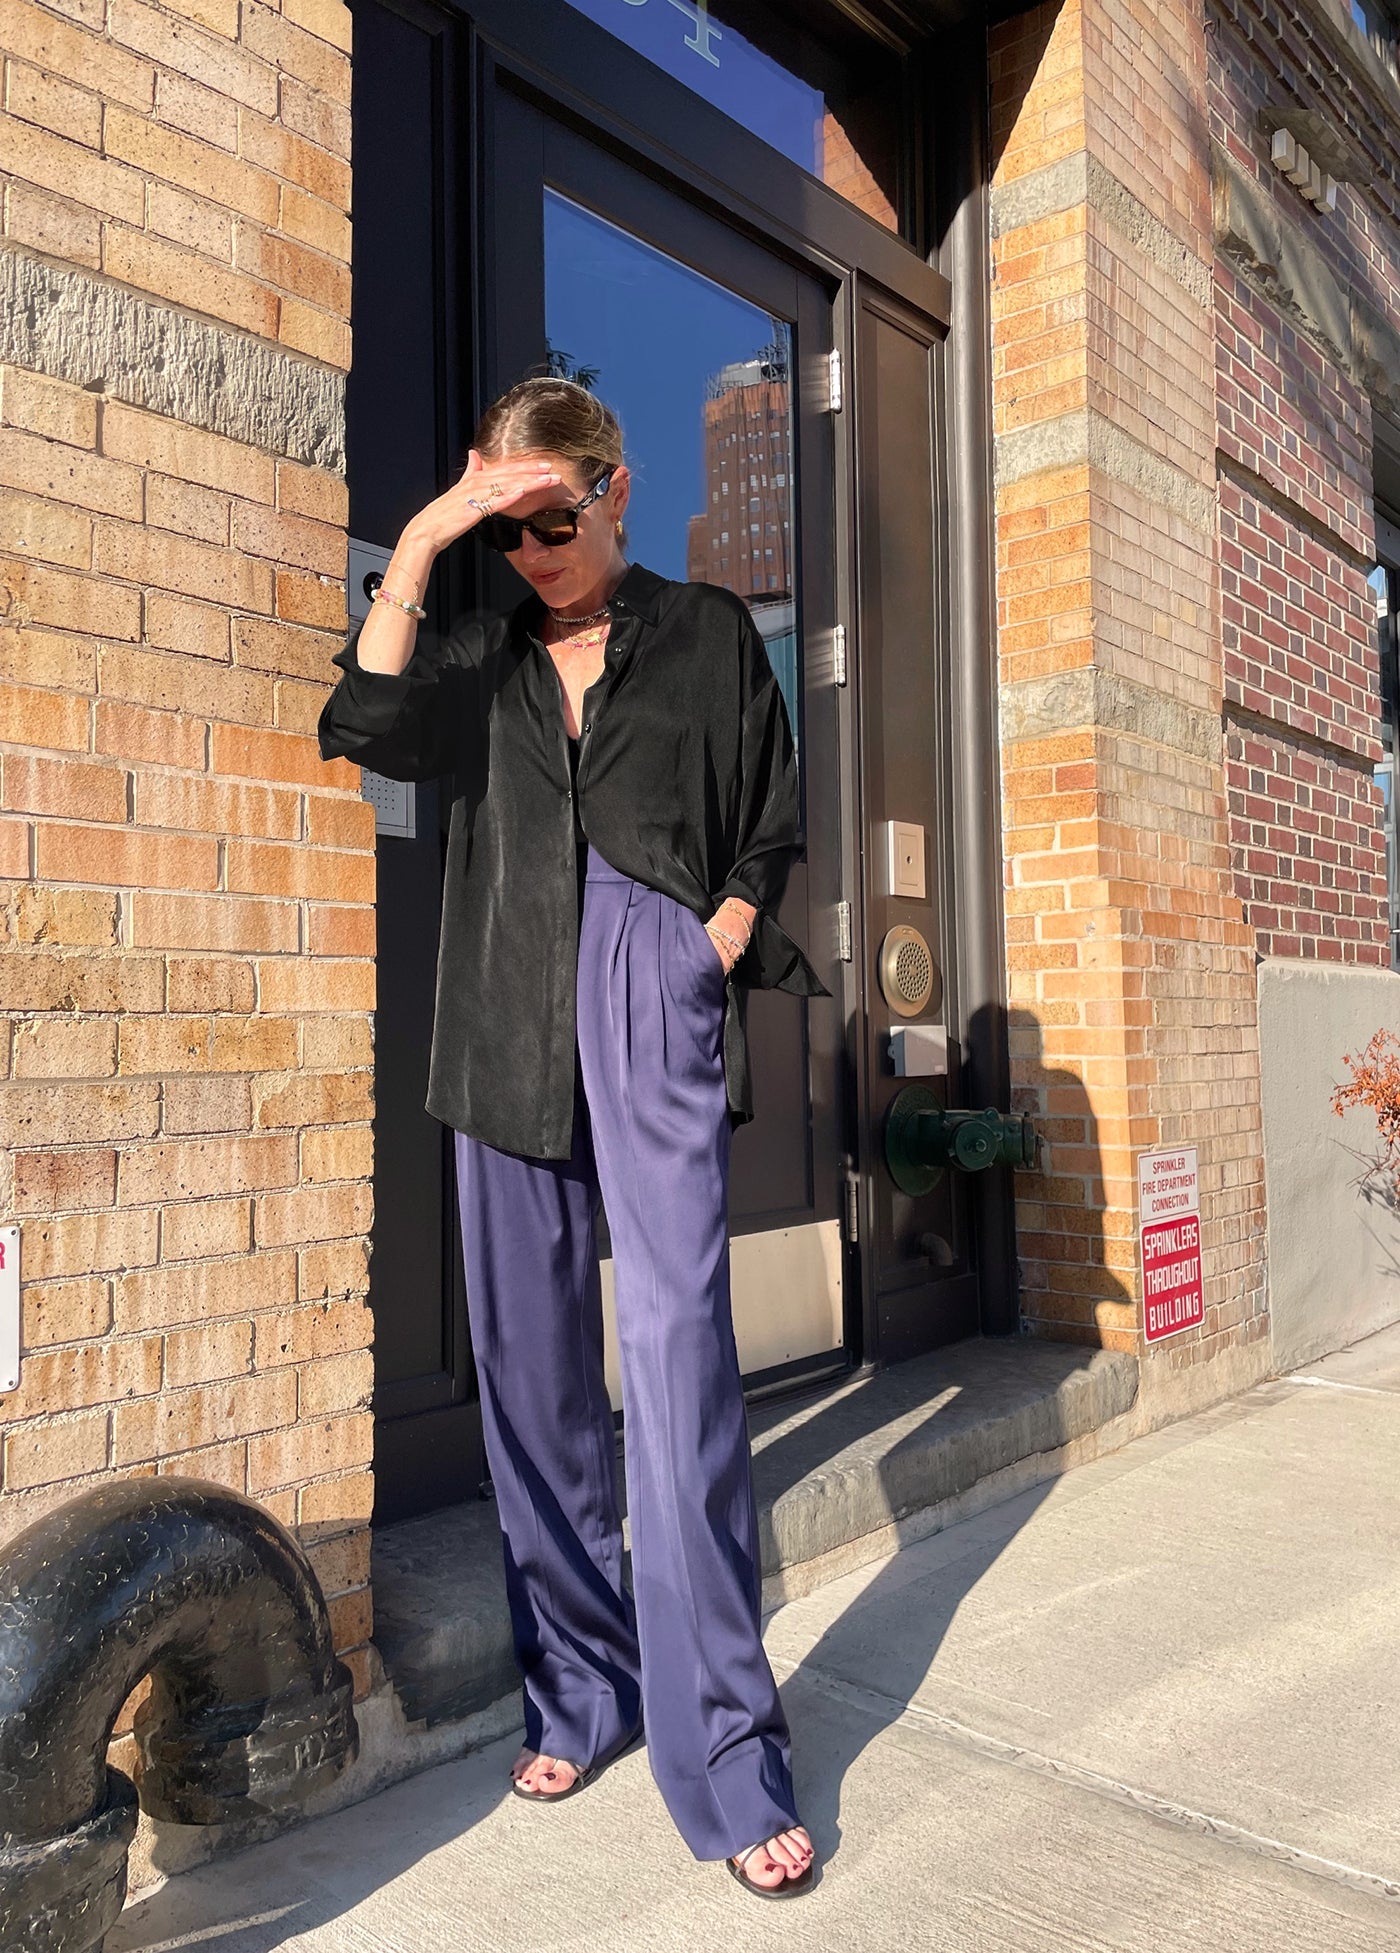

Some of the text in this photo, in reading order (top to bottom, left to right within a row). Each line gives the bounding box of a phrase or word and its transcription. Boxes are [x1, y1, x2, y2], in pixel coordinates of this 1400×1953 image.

[1152, 1157, 1185, 1174] SPRINKLER
[1142, 1173, 1196, 1195] FIRE DEPARTMENT
[1152, 1193, 1189, 1212] CONNECTION
[1144, 1223, 1198, 1260] SPRINKLERS
[1146, 1257, 1199, 1296] THROUGHOUT
[1149, 1291, 1199, 1332] BUILDING
